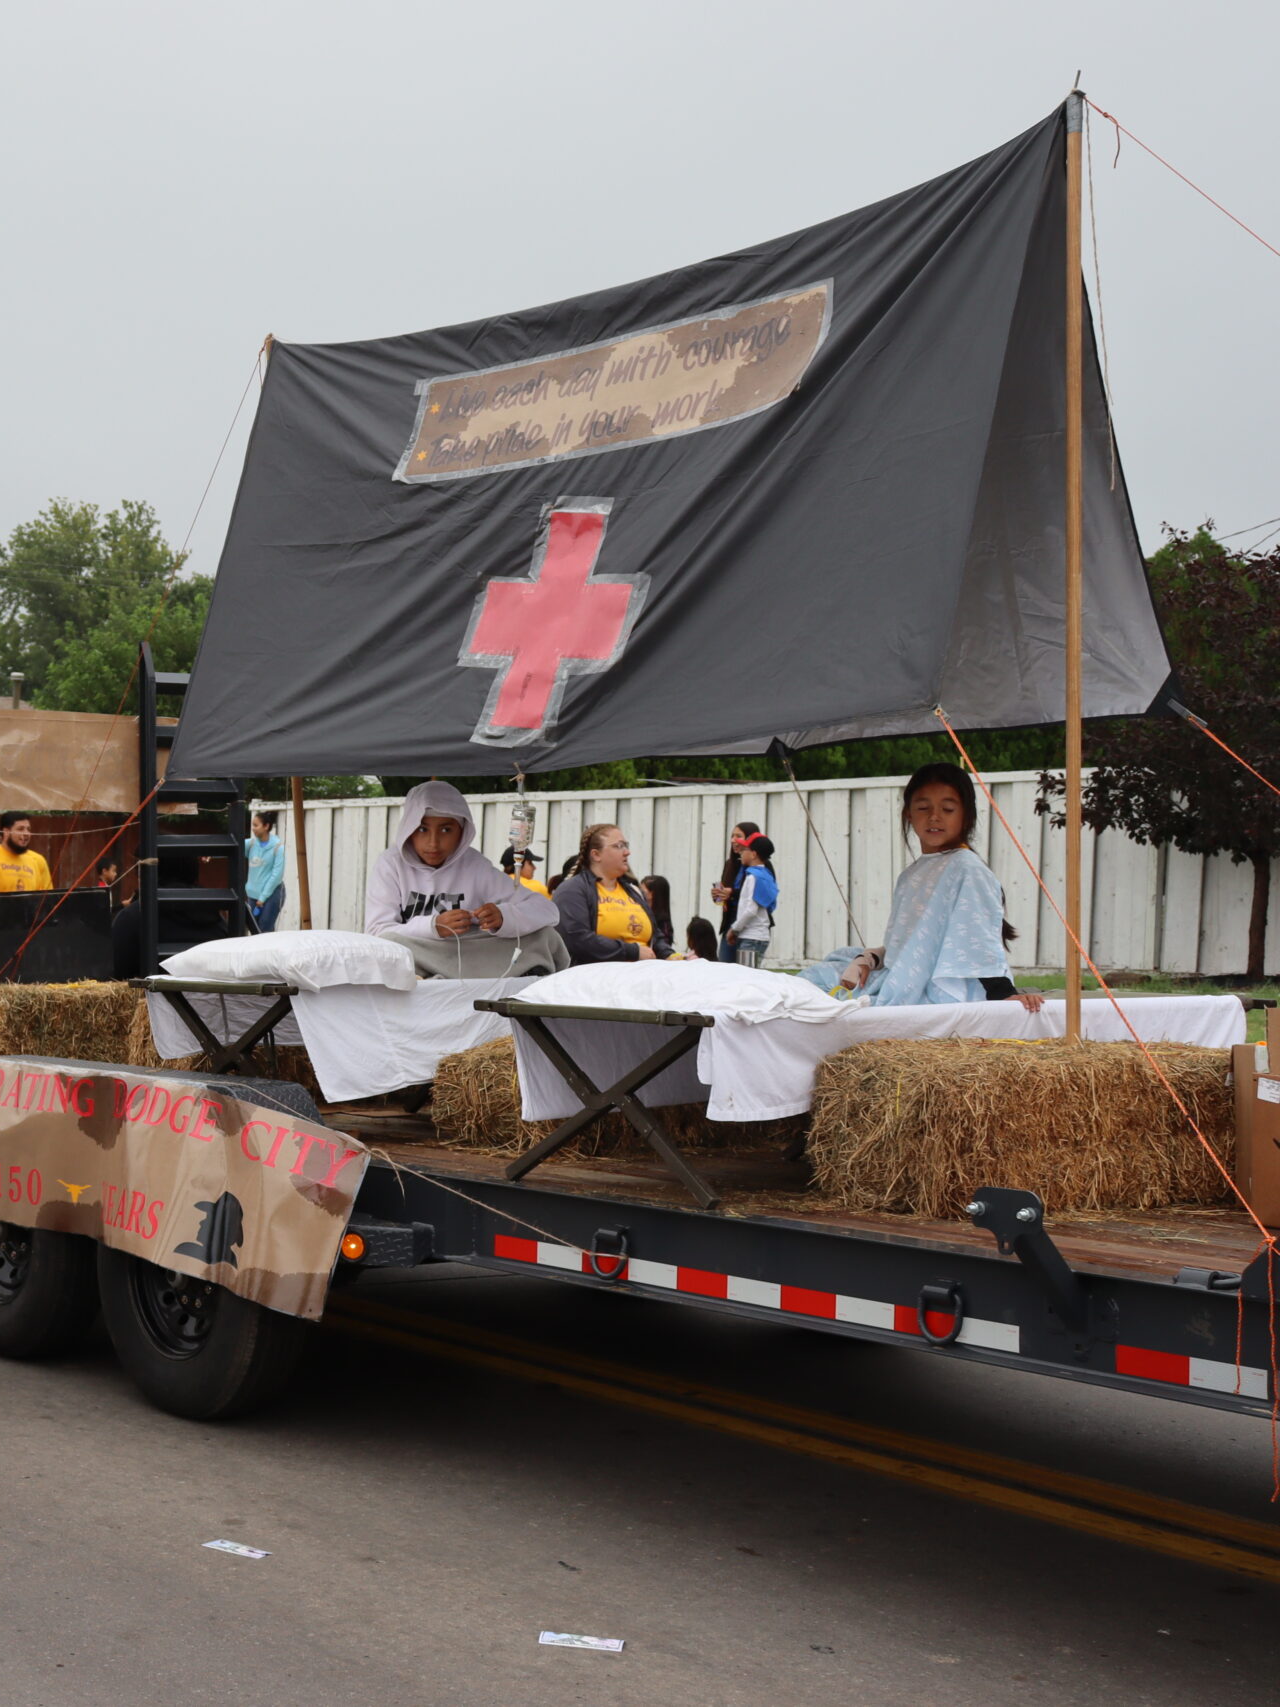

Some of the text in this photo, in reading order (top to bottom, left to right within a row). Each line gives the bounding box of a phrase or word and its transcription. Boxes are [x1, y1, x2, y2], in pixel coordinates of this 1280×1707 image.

[491, 371, 551, 411] each
[557, 362, 603, 402] day
[604, 341, 673, 388] with
[681, 314, 792, 373] courage
[426, 379, 722, 467] Take pride in your work
[113, 1078, 223, 1143] DODGE
[240, 1119, 361, 1188] CITY
